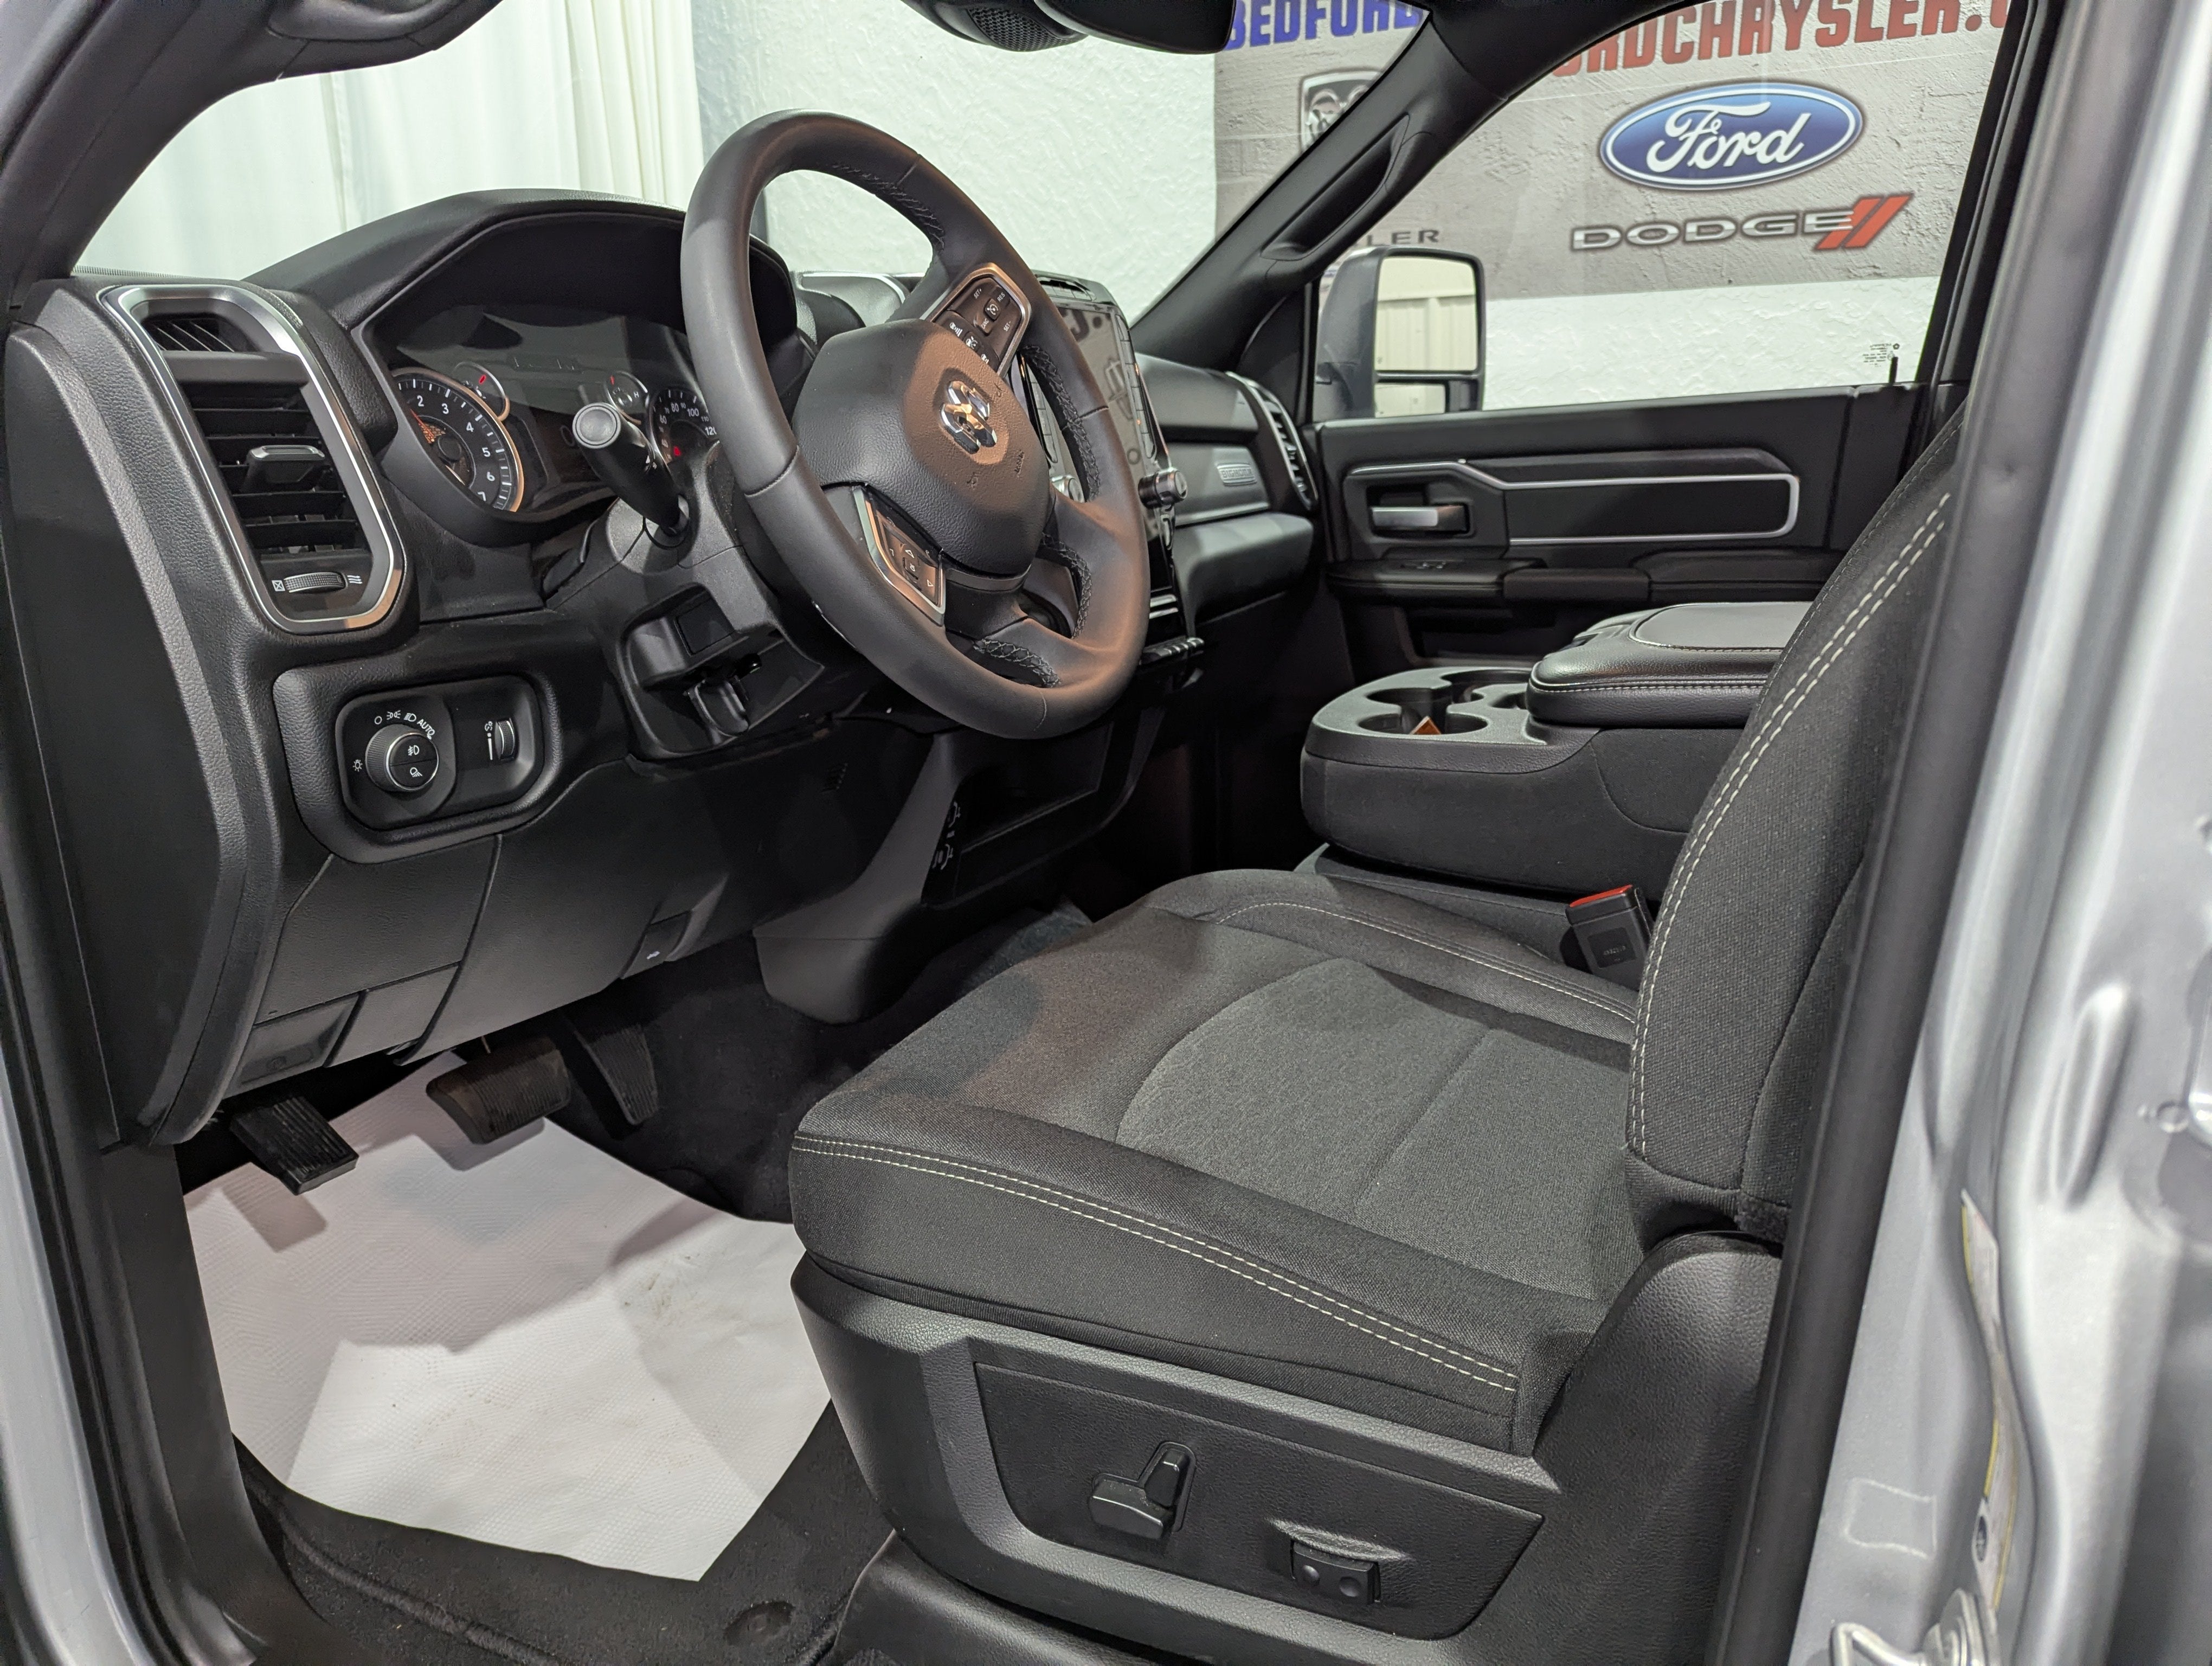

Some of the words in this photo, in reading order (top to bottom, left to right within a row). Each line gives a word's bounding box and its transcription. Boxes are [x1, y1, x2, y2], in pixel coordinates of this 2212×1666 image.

[1646, 101, 1812, 172] Ford
[1573, 209, 1854, 251] DODGE
[417, 395, 424, 407] 2
[441, 403, 449, 414] 3
[687, 408, 699, 417] 100
[466, 422, 474, 432] 4
[482, 447, 491, 457] 5
[487, 472, 495, 482] 6
[478, 491, 486, 501] 7
[416, 719, 435, 736] AUTO
